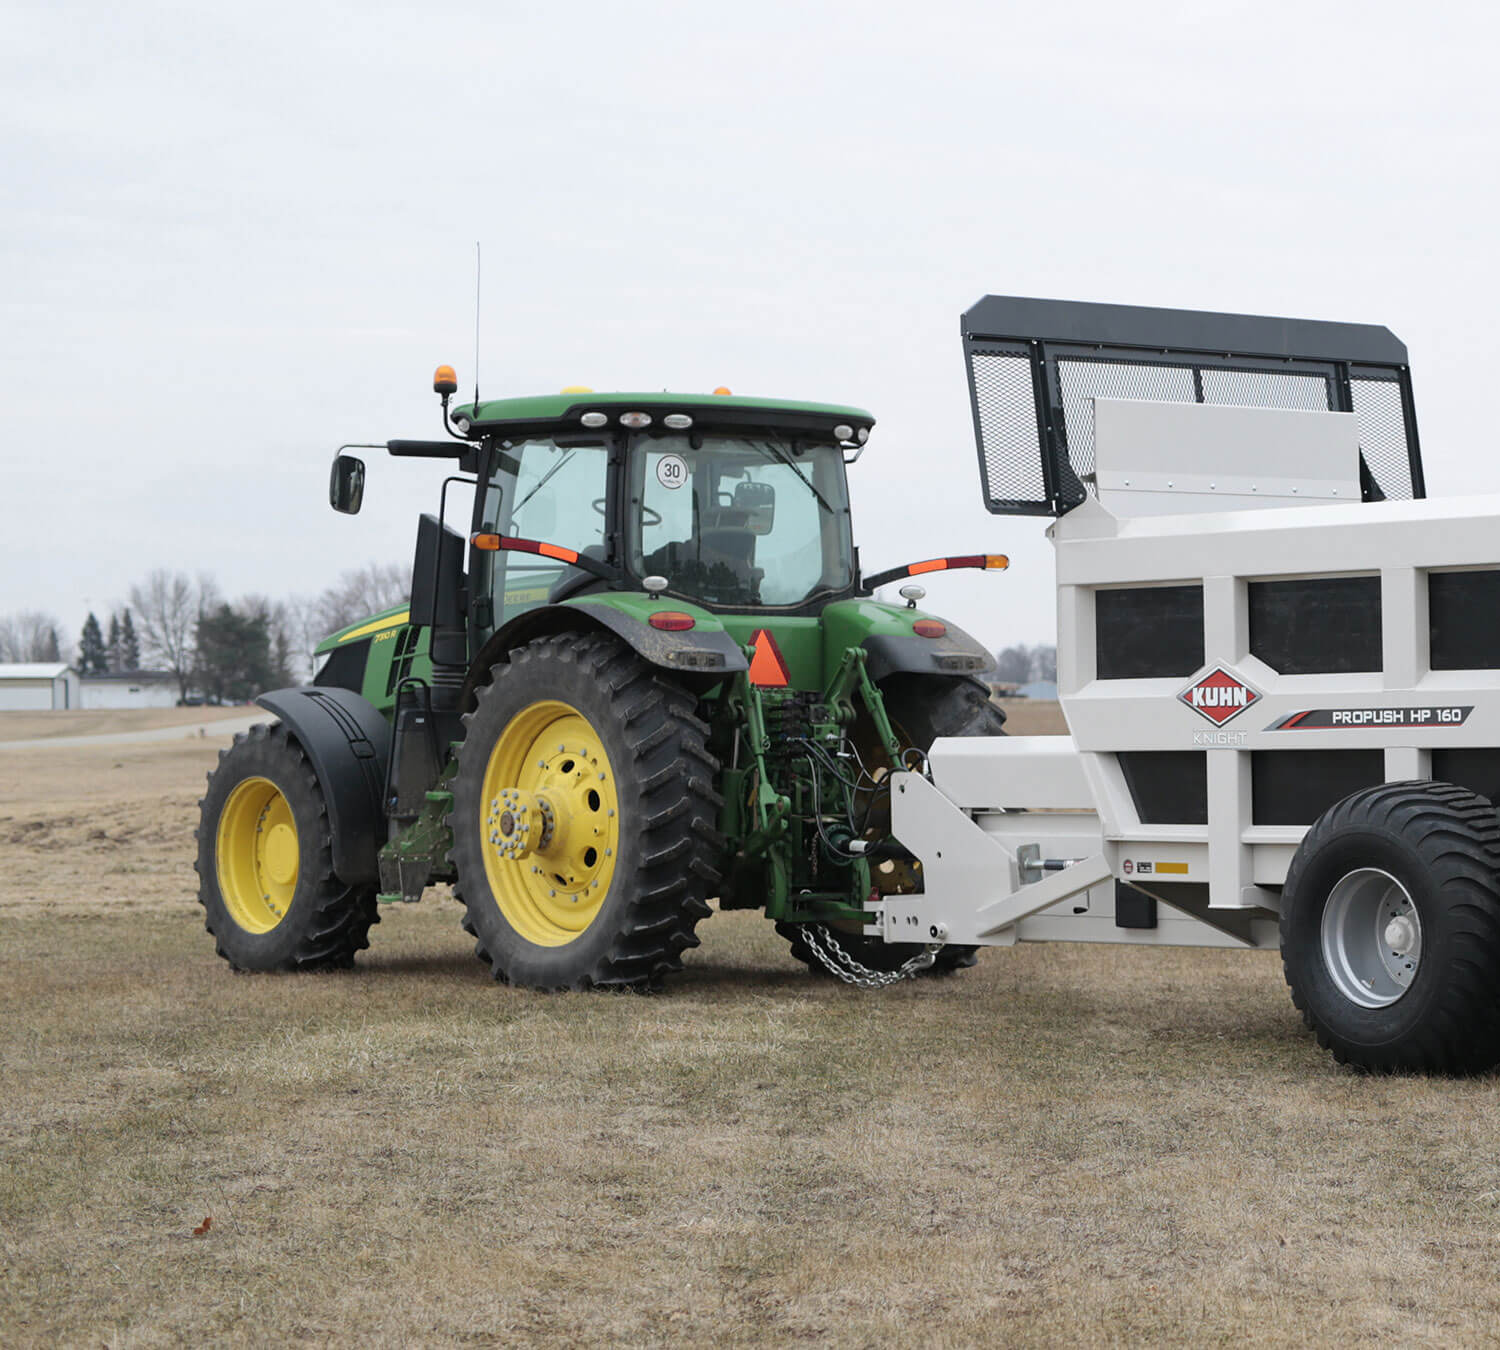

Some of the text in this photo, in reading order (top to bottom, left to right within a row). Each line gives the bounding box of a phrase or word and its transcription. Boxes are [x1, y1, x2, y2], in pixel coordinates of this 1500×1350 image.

[664, 463, 680, 478] 30
[1192, 687, 1247, 706] KUHN
[1332, 709, 1462, 724] PROPUSH HP 160
[1193, 732, 1247, 745] KNIGHT
